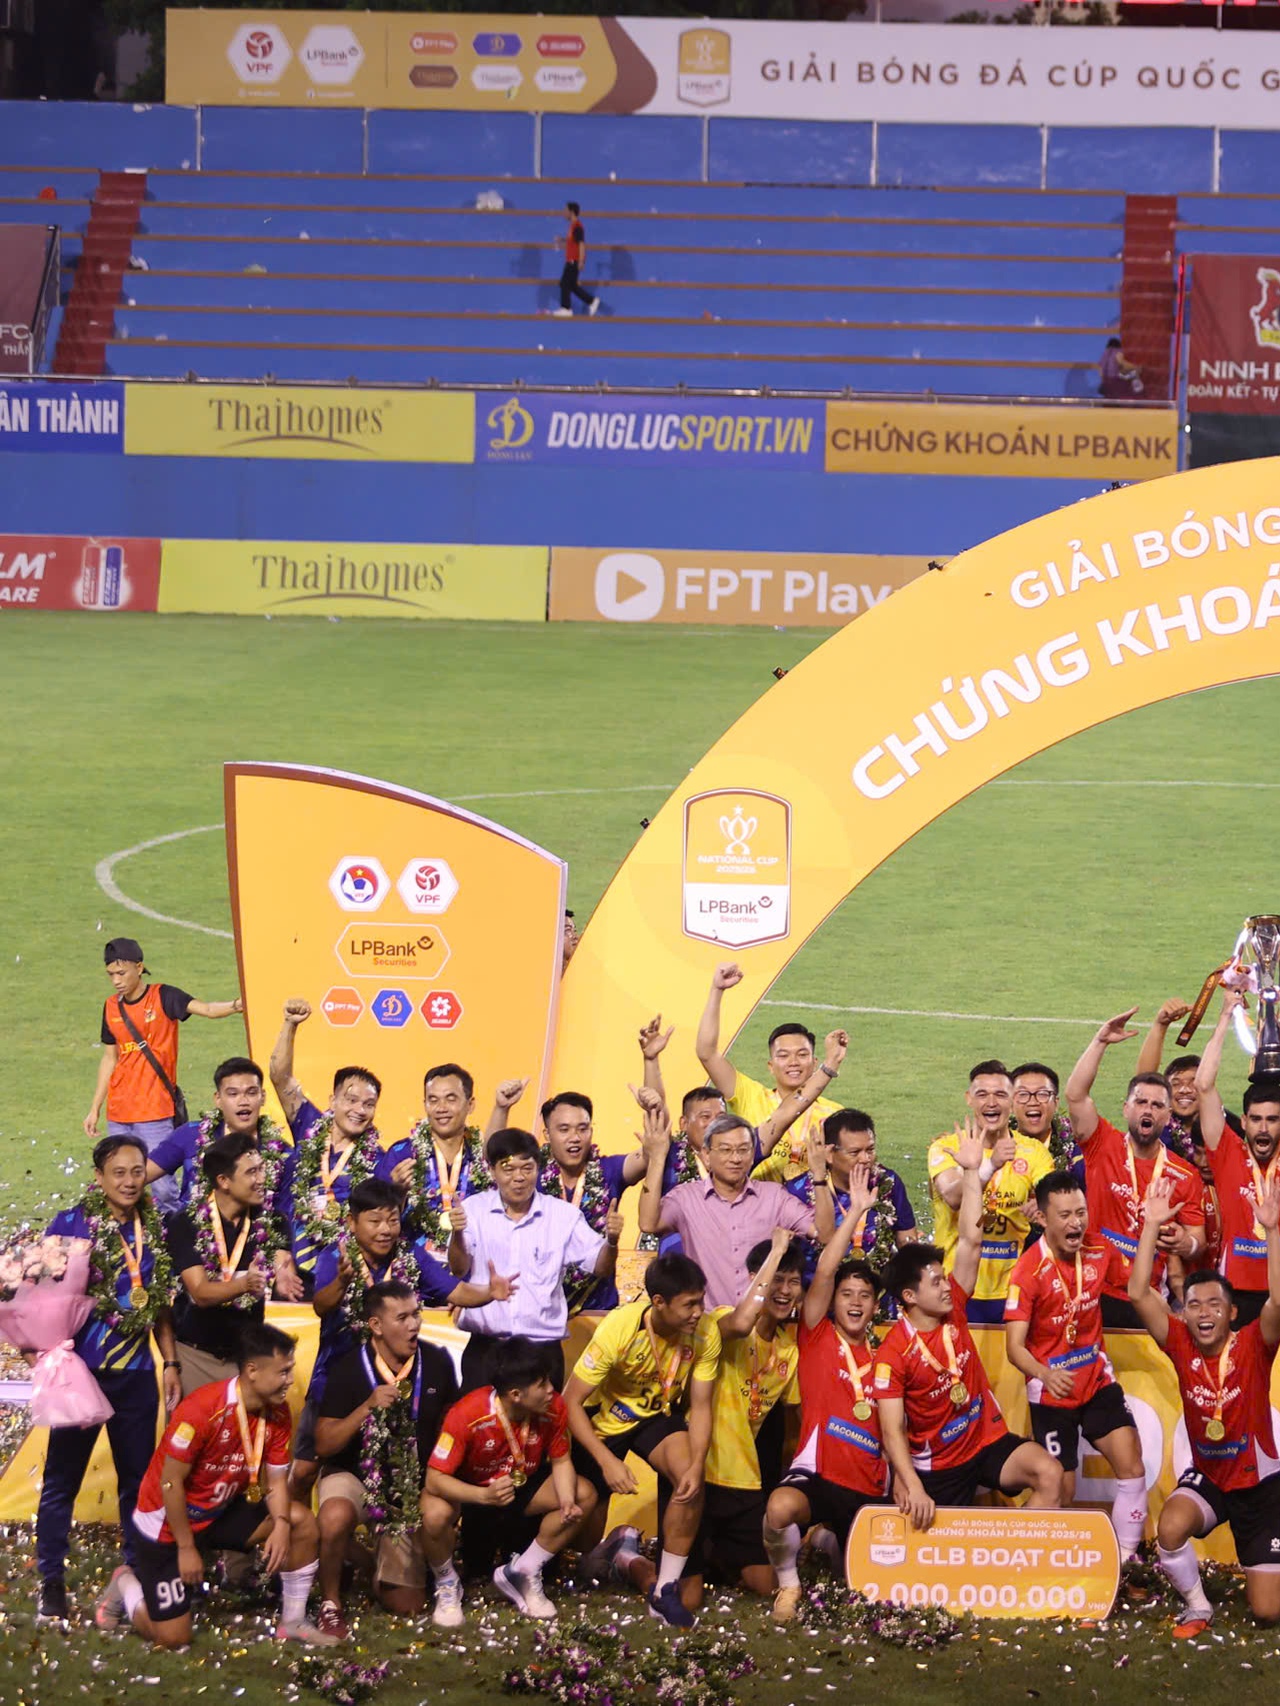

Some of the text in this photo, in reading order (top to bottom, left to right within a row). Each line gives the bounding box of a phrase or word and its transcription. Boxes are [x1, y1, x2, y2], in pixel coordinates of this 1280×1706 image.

[246, 63, 273, 73] VPF
[760, 52, 837, 84] GIẢI
[857, 55, 959, 86] BÓNG
[979, 56, 1027, 87] ĐÁ
[1048, 57, 1118, 88] CÚP
[1137, 52, 1242, 91] QUỐC
[3, 341, 30, 356] THẮN
[1200, 360, 1270, 381] NINH
[36, 391, 119, 434] THÀNH
[547, 409, 814, 455] DONGLUCSPORT.VN
[831, 420, 1172, 461] CHỨNG KHOÁN LPBANK
[1009, 539, 1120, 609] GIẢI
[676, 568, 772, 611] FPT
[851, 631, 1091, 800] CHỨNG
[415, 894, 441, 904] VPF
[699, 899, 758, 914] LPBank
[719, 915, 759, 924] Securities
[351, 940, 417, 957] LPBank
[373, 957, 418, 967] Securities
[1045, 1429, 1062, 1456] 6
[928, 1523, 1092, 1540] CHỨNG KHOÁN LPBANK 2025/26
[917, 1544, 1102, 1572] CLB ĐOẠT CÚP
[156, 1577, 186, 1611] 90
[864, 1582, 1086, 1610] 2000.000.000
